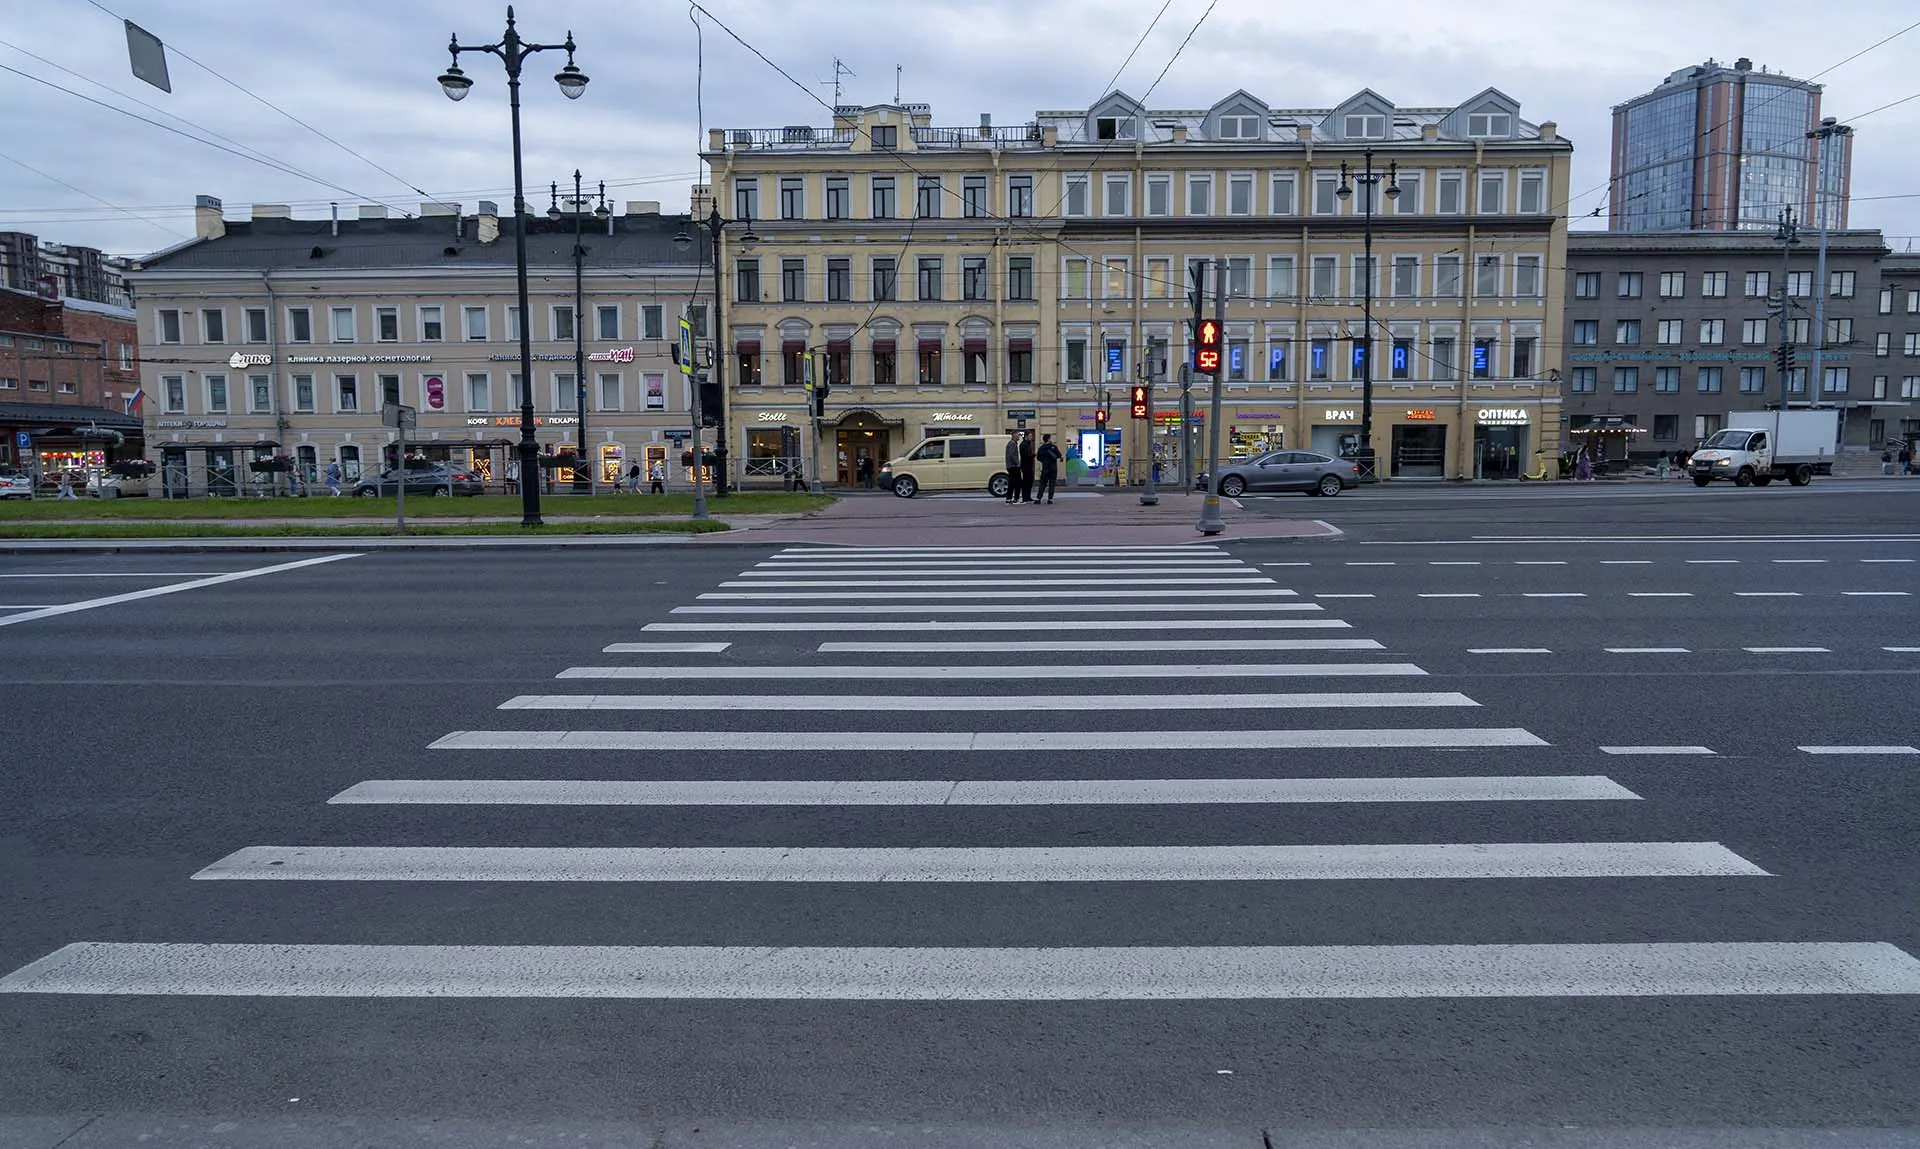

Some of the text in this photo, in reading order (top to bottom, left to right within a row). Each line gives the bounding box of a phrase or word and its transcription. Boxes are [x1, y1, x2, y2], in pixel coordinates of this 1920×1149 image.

[287, 354, 431, 365] клиника лазерной косметологии
[1200, 352, 1217, 367] 52
[1134, 405, 1146, 416] 52
[1325, 410, 1354, 420] ВРАЧ
[1478, 409, 1527, 420] ОПТИКА
[467, 417, 489, 425] КОФЕ
[758, 412, 788, 422] Stolle
[932, 412, 973, 422] Штолле
